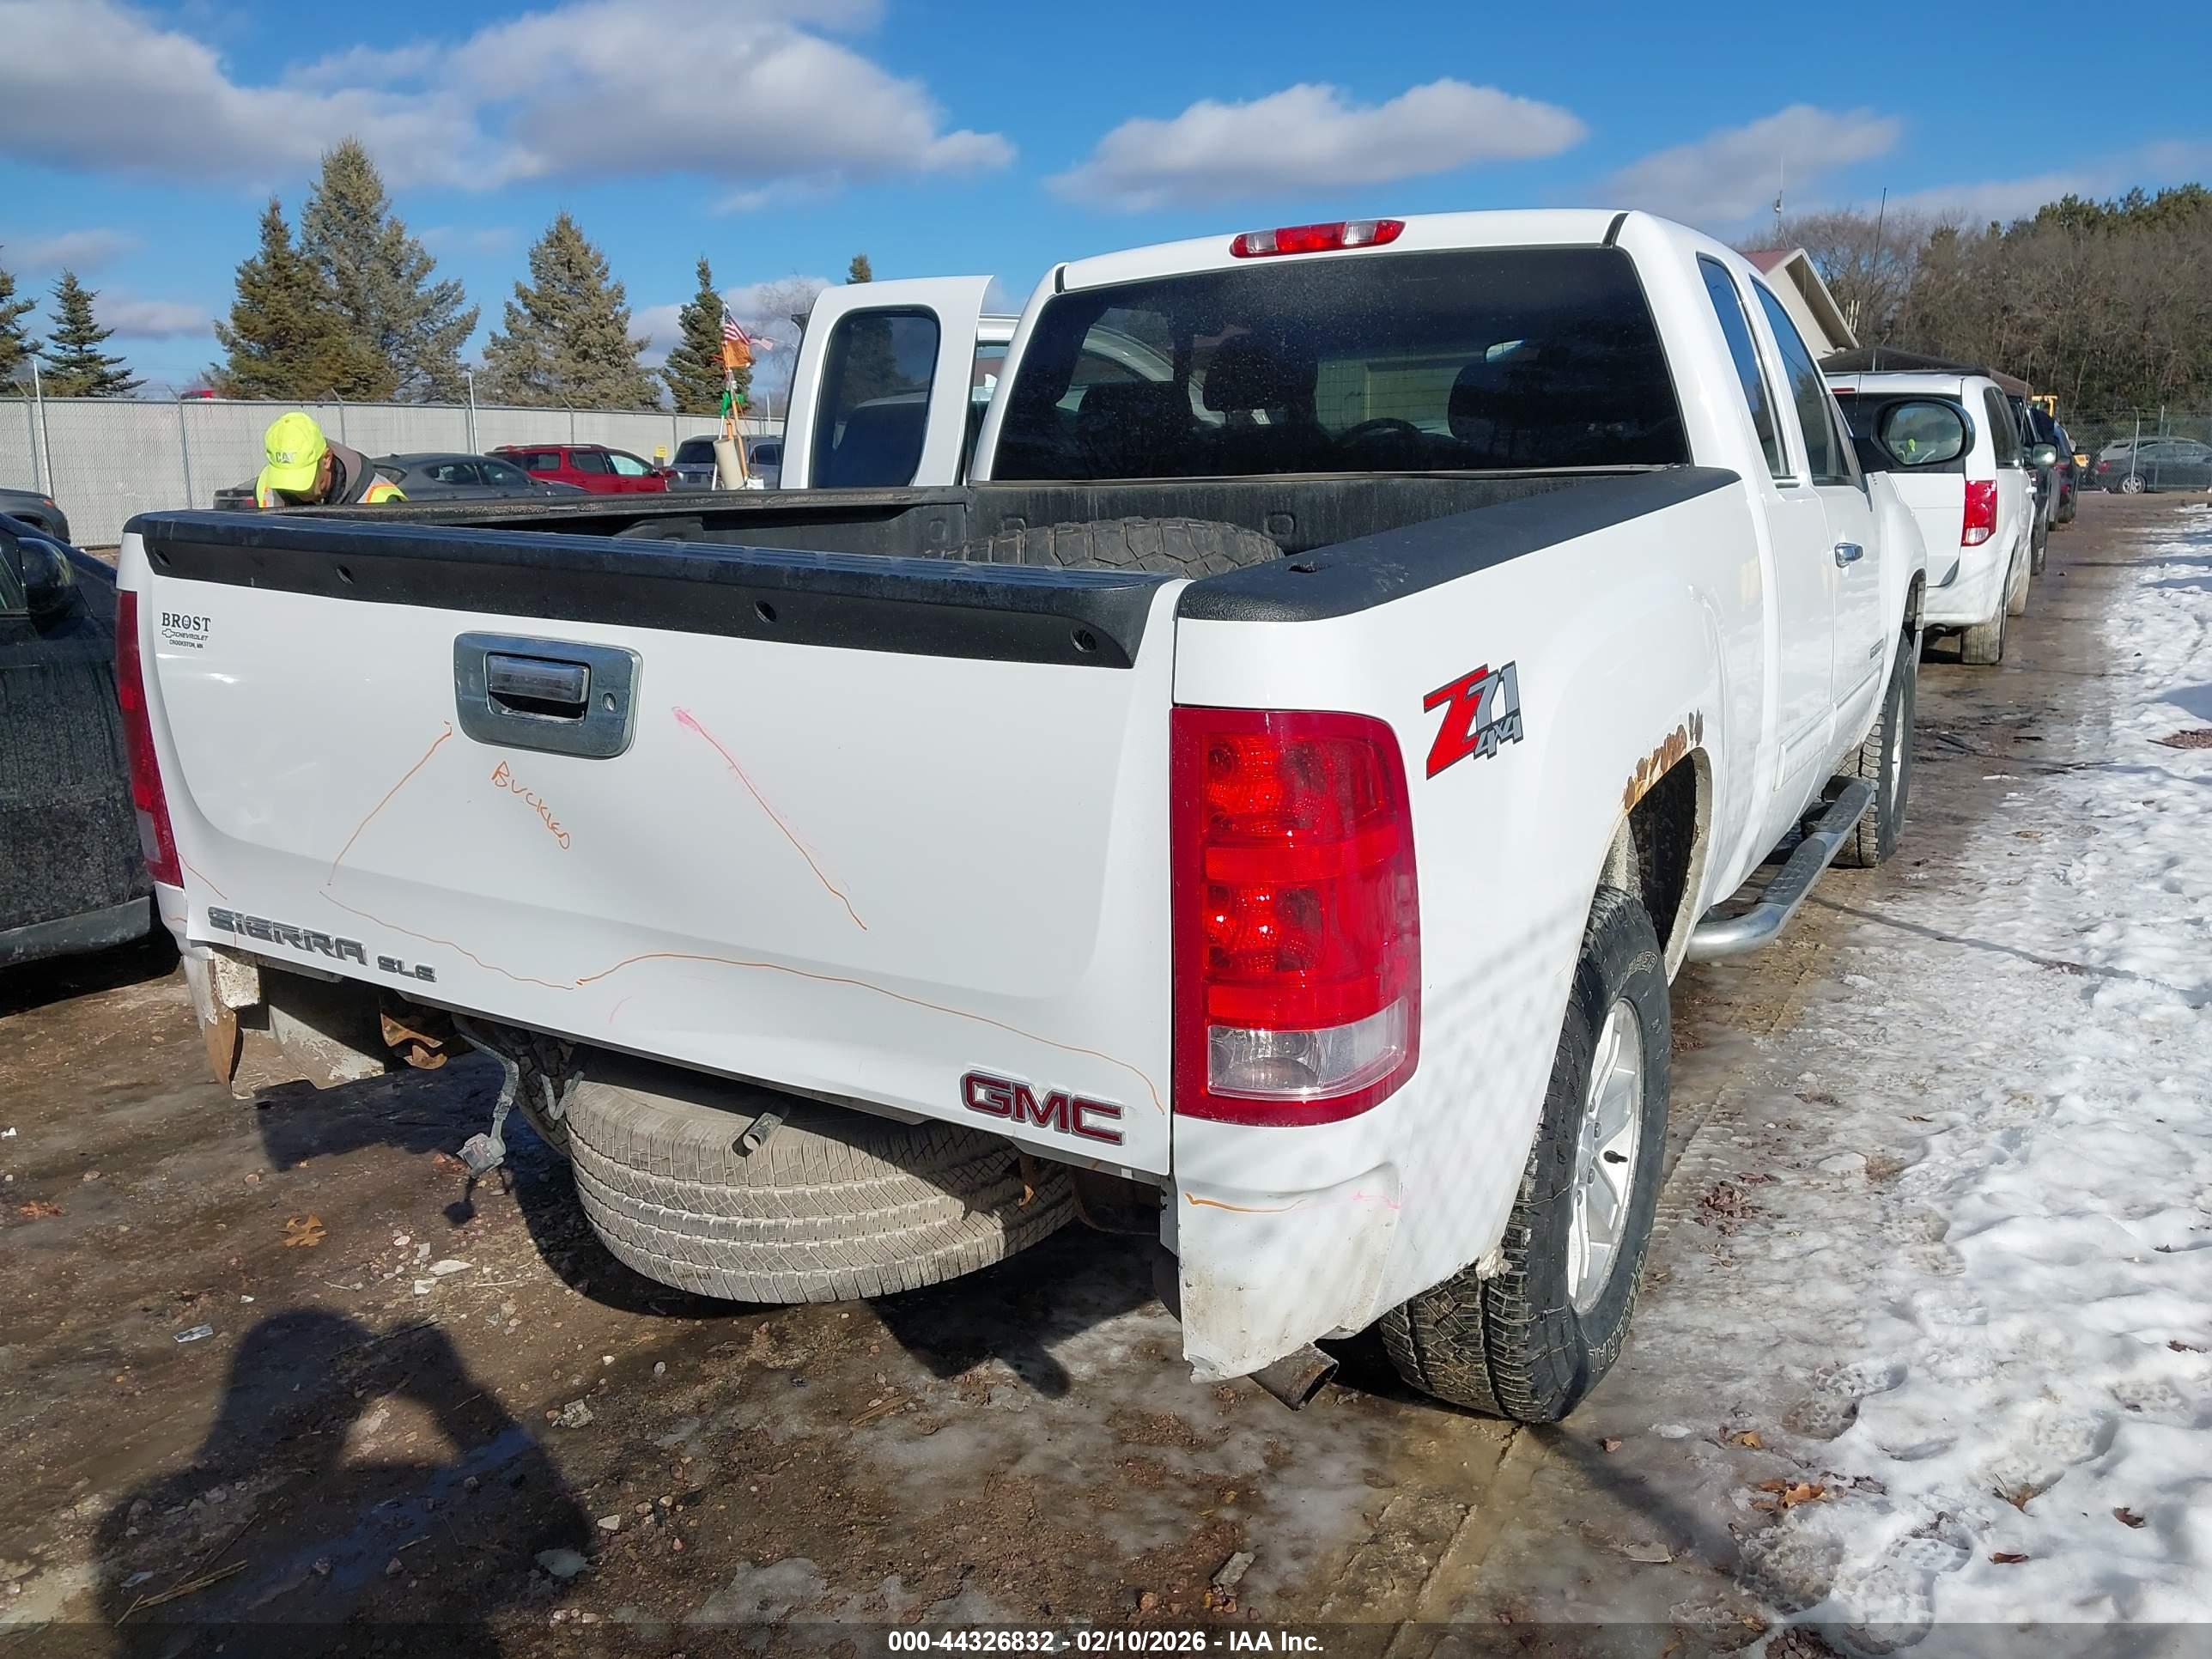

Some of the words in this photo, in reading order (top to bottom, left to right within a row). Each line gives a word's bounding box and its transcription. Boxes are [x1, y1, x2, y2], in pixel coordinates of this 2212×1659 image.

[161, 611, 211, 632] BROST
[174, 631, 209, 641] CHEVROLET
[1423, 660, 1520, 781] Z71
[208, 906, 369, 967] SIERRA
[377, 955, 437, 983] SLE
[960, 1069, 1127, 1146] GMC
[1589, 1250, 1645, 1374] GENERAL
